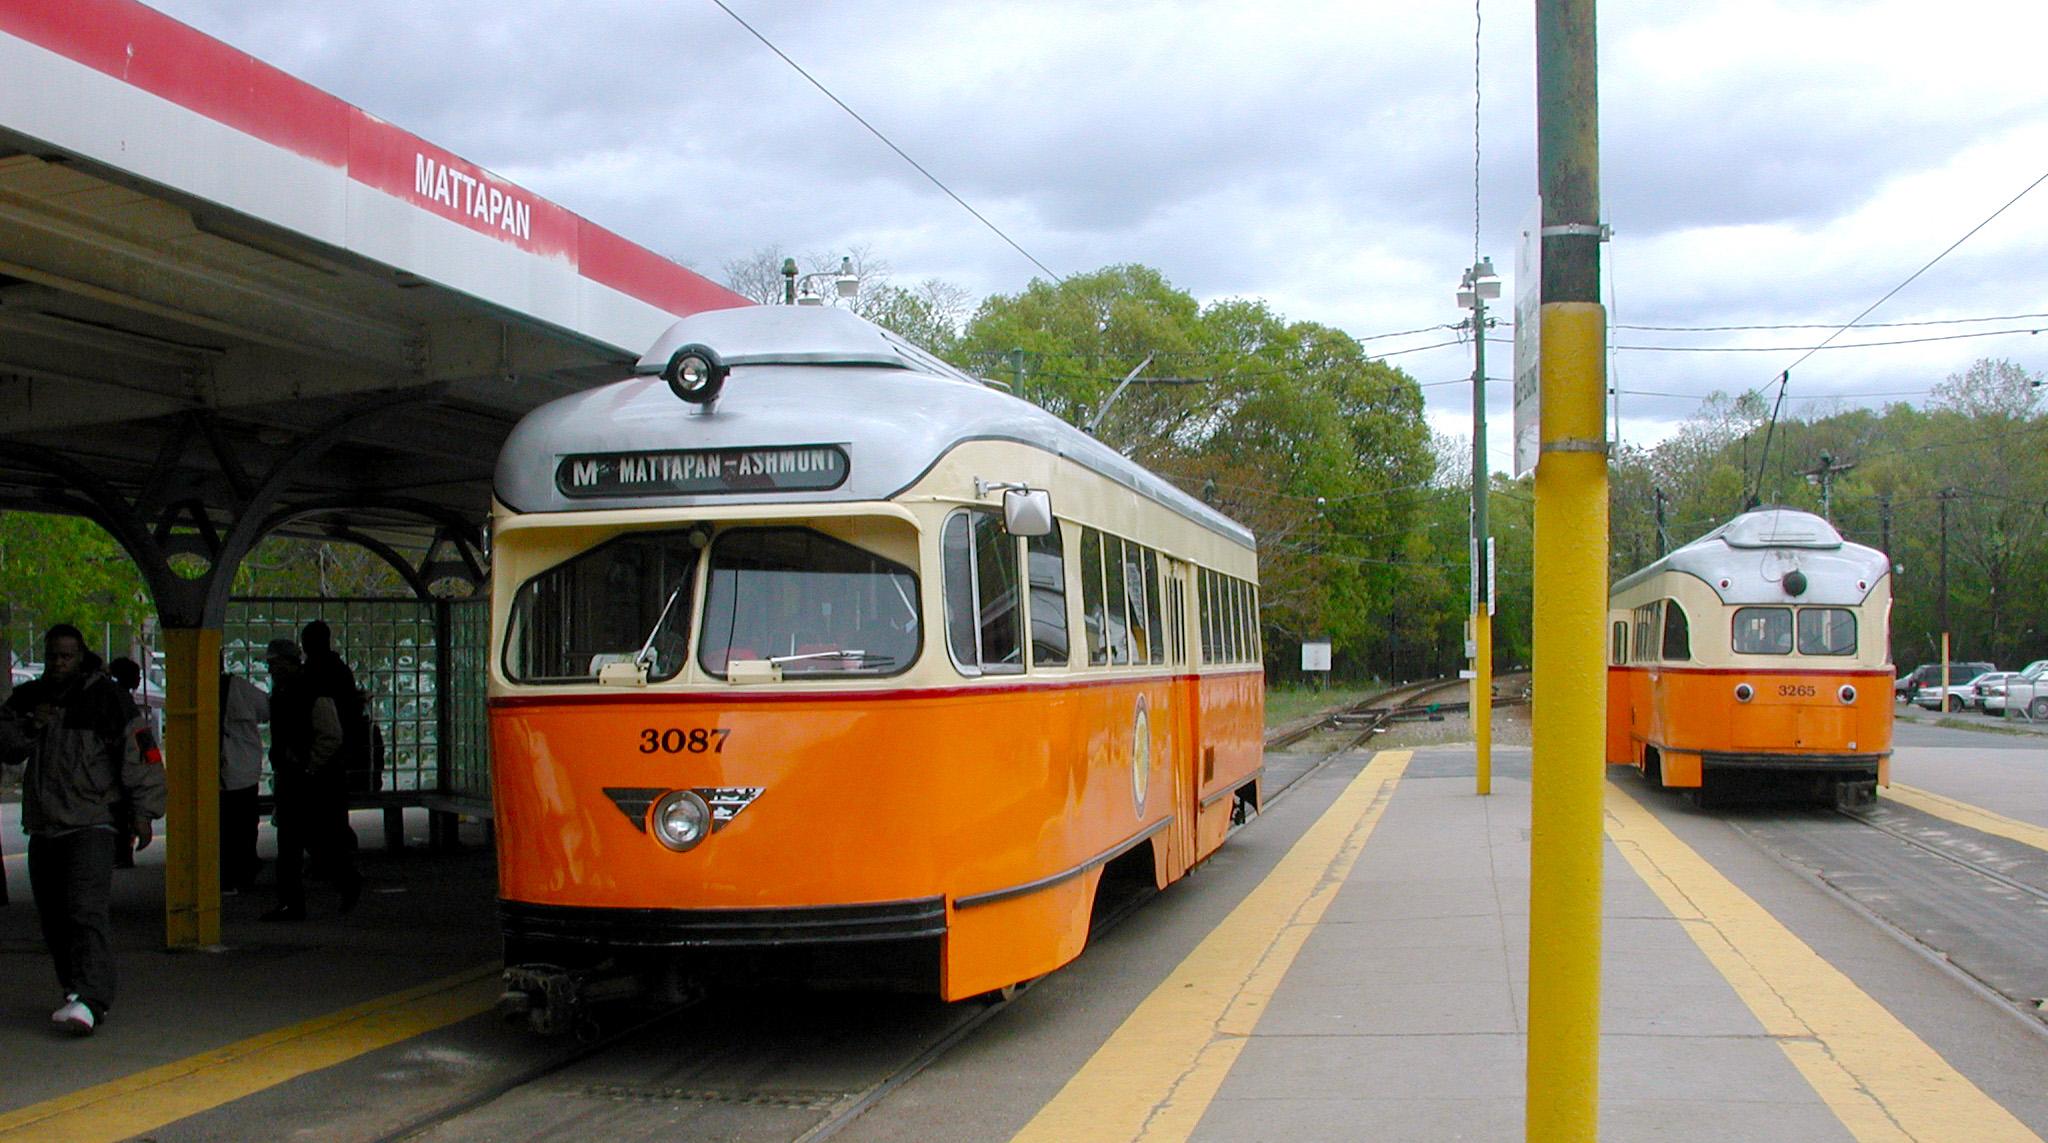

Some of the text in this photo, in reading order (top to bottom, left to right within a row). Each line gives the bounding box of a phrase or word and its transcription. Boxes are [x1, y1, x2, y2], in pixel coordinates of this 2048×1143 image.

[415, 152, 530, 240] MATTAPAN
[1778, 684, 1817, 697] 3265
[639, 728, 731, 753] 3087
